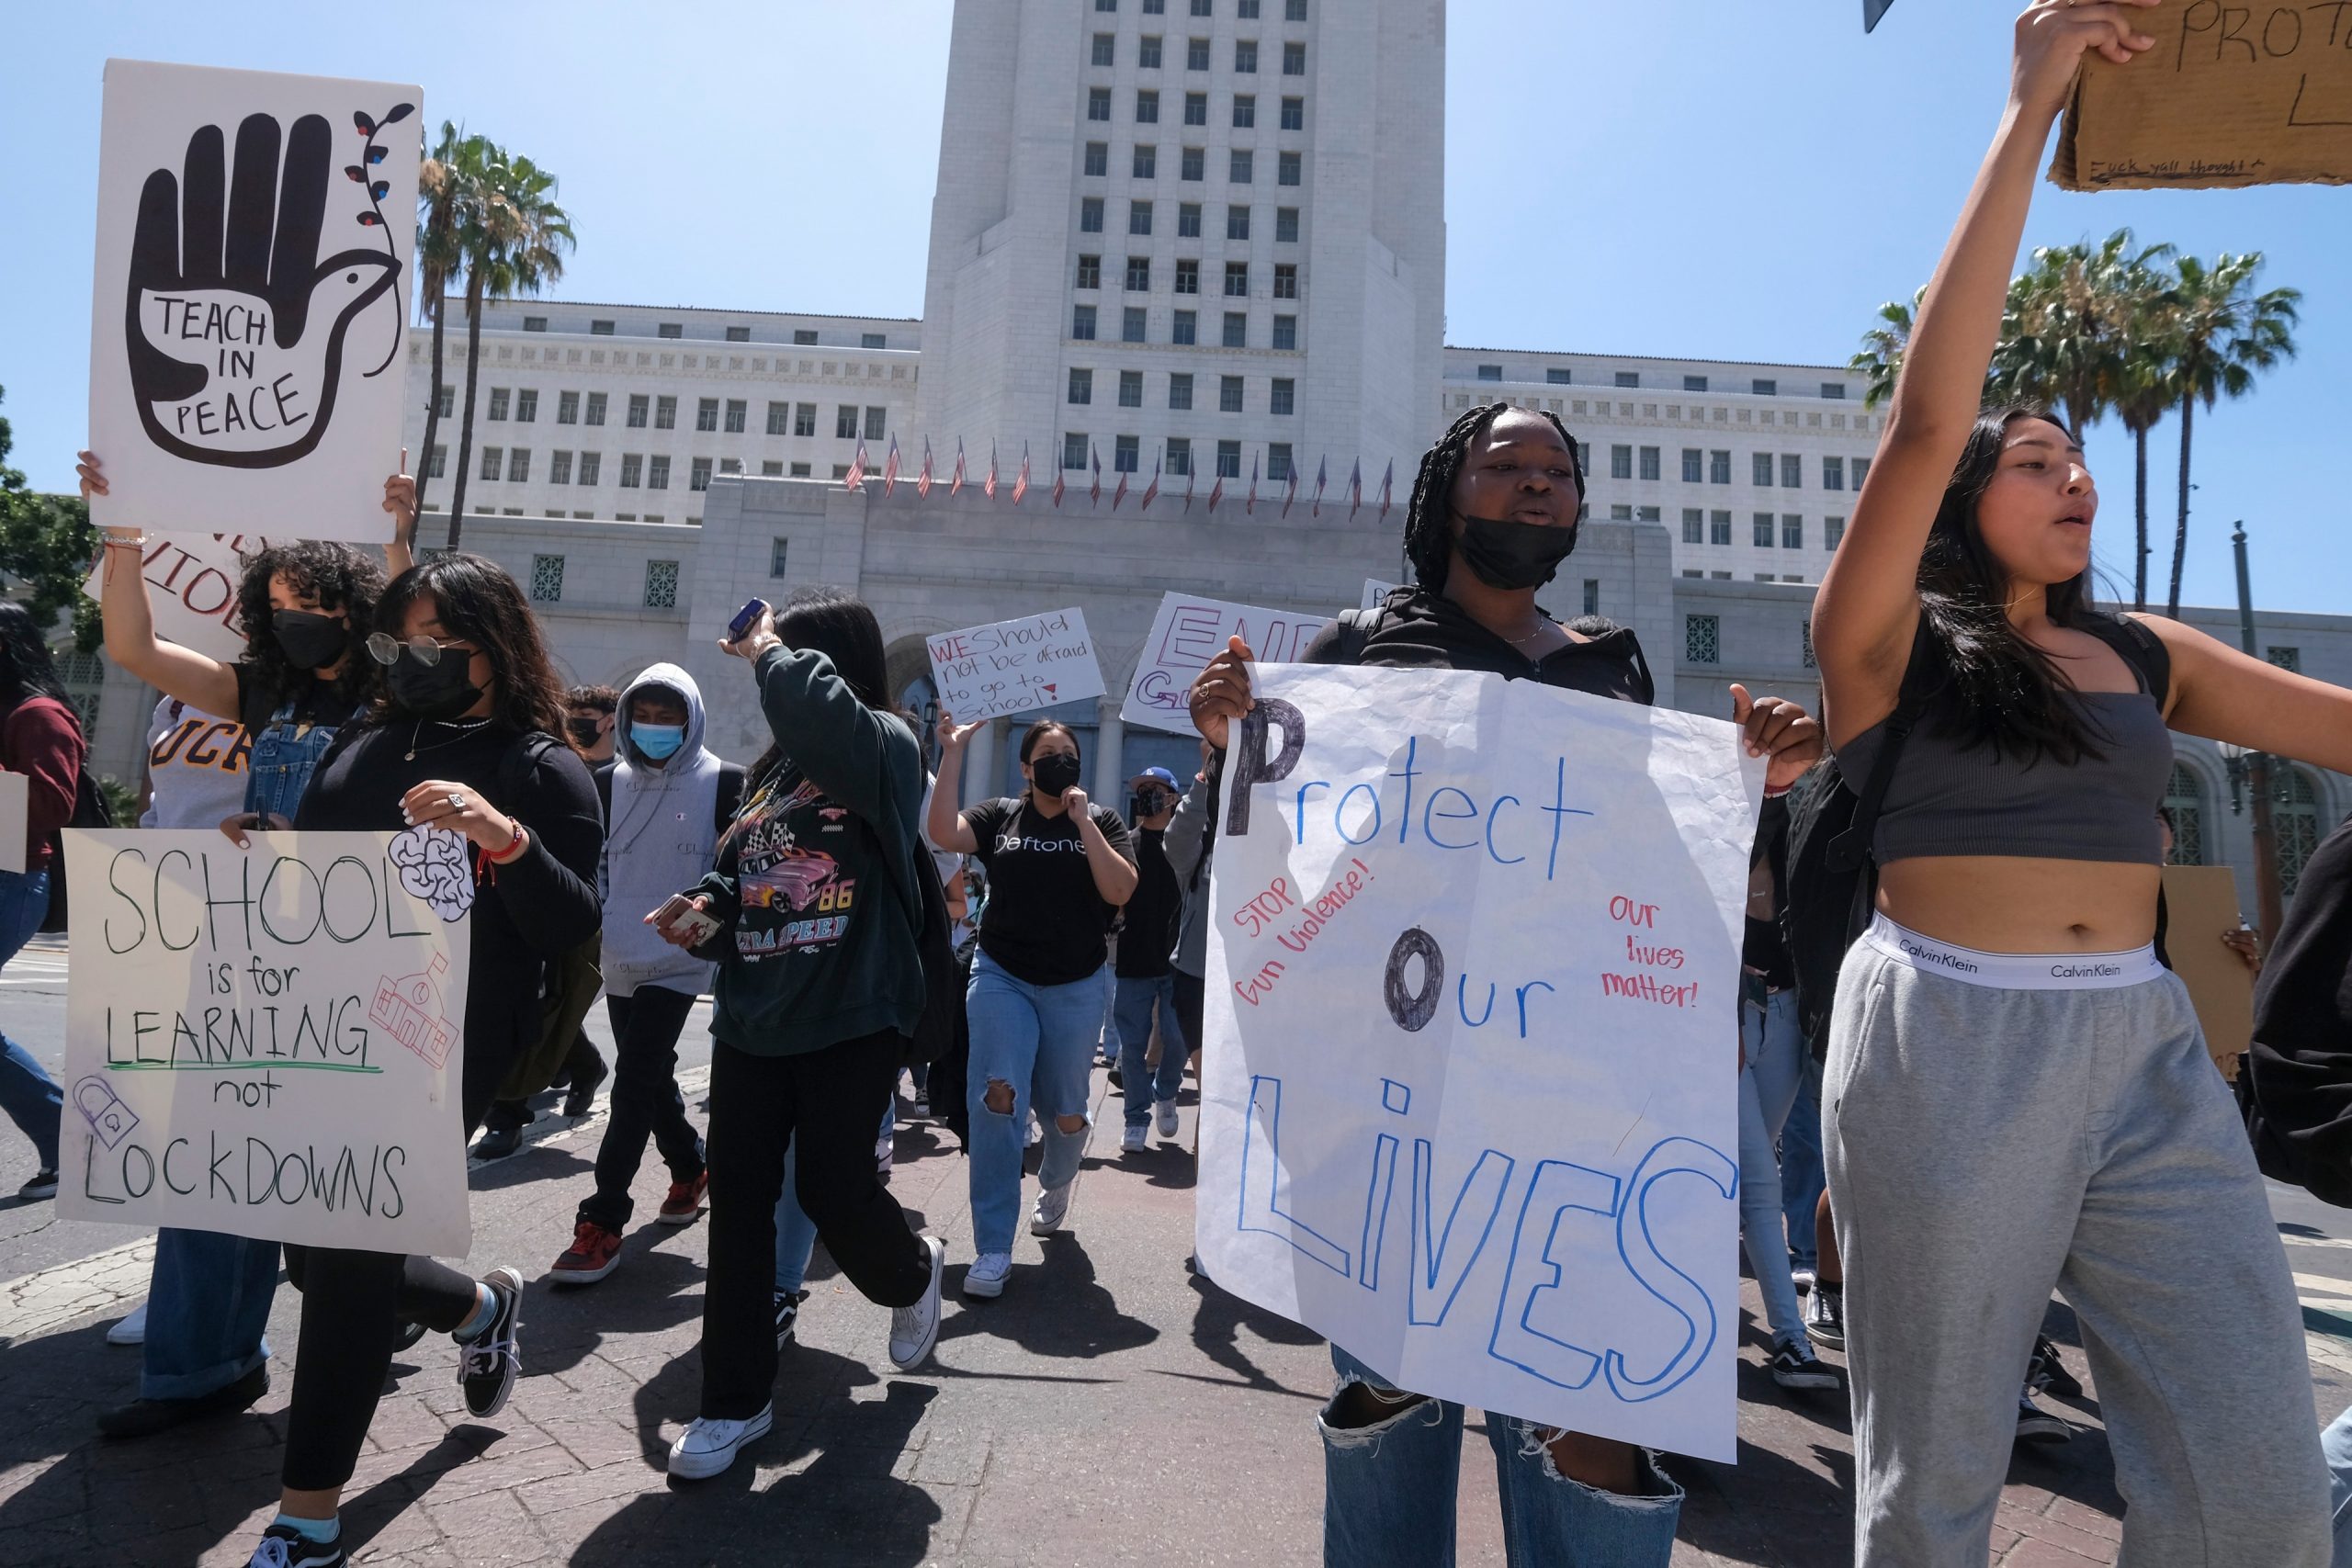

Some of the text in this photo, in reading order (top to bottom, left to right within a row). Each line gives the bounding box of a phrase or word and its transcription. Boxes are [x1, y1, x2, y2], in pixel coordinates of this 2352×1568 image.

[2177, 0, 2352, 72] PROT
[2090, 160, 2141, 176] Fuck
[153, 296, 266, 345] TEACH
[218, 349, 254, 379] IN
[176, 372, 309, 435] PEACE
[929, 635, 978, 664] WE
[943, 641, 1088, 684] not be afraid
[946, 673, 1045, 704] to go to
[1226, 697, 1594, 880] Protect
[993, 834, 1088, 855] Deftone
[105, 847, 433, 954] SCHOOL
[816, 879, 855, 913] 86
[1234, 876, 1295, 938] STOP
[1627, 935, 1684, 969] lives
[209, 955, 300, 997] is for
[1235, 961, 1286, 1007] Gun
[1601, 973, 1699, 1008] matter!
[107, 995, 368, 1069] LEARNING
[214, 1069, 283, 1108] not
